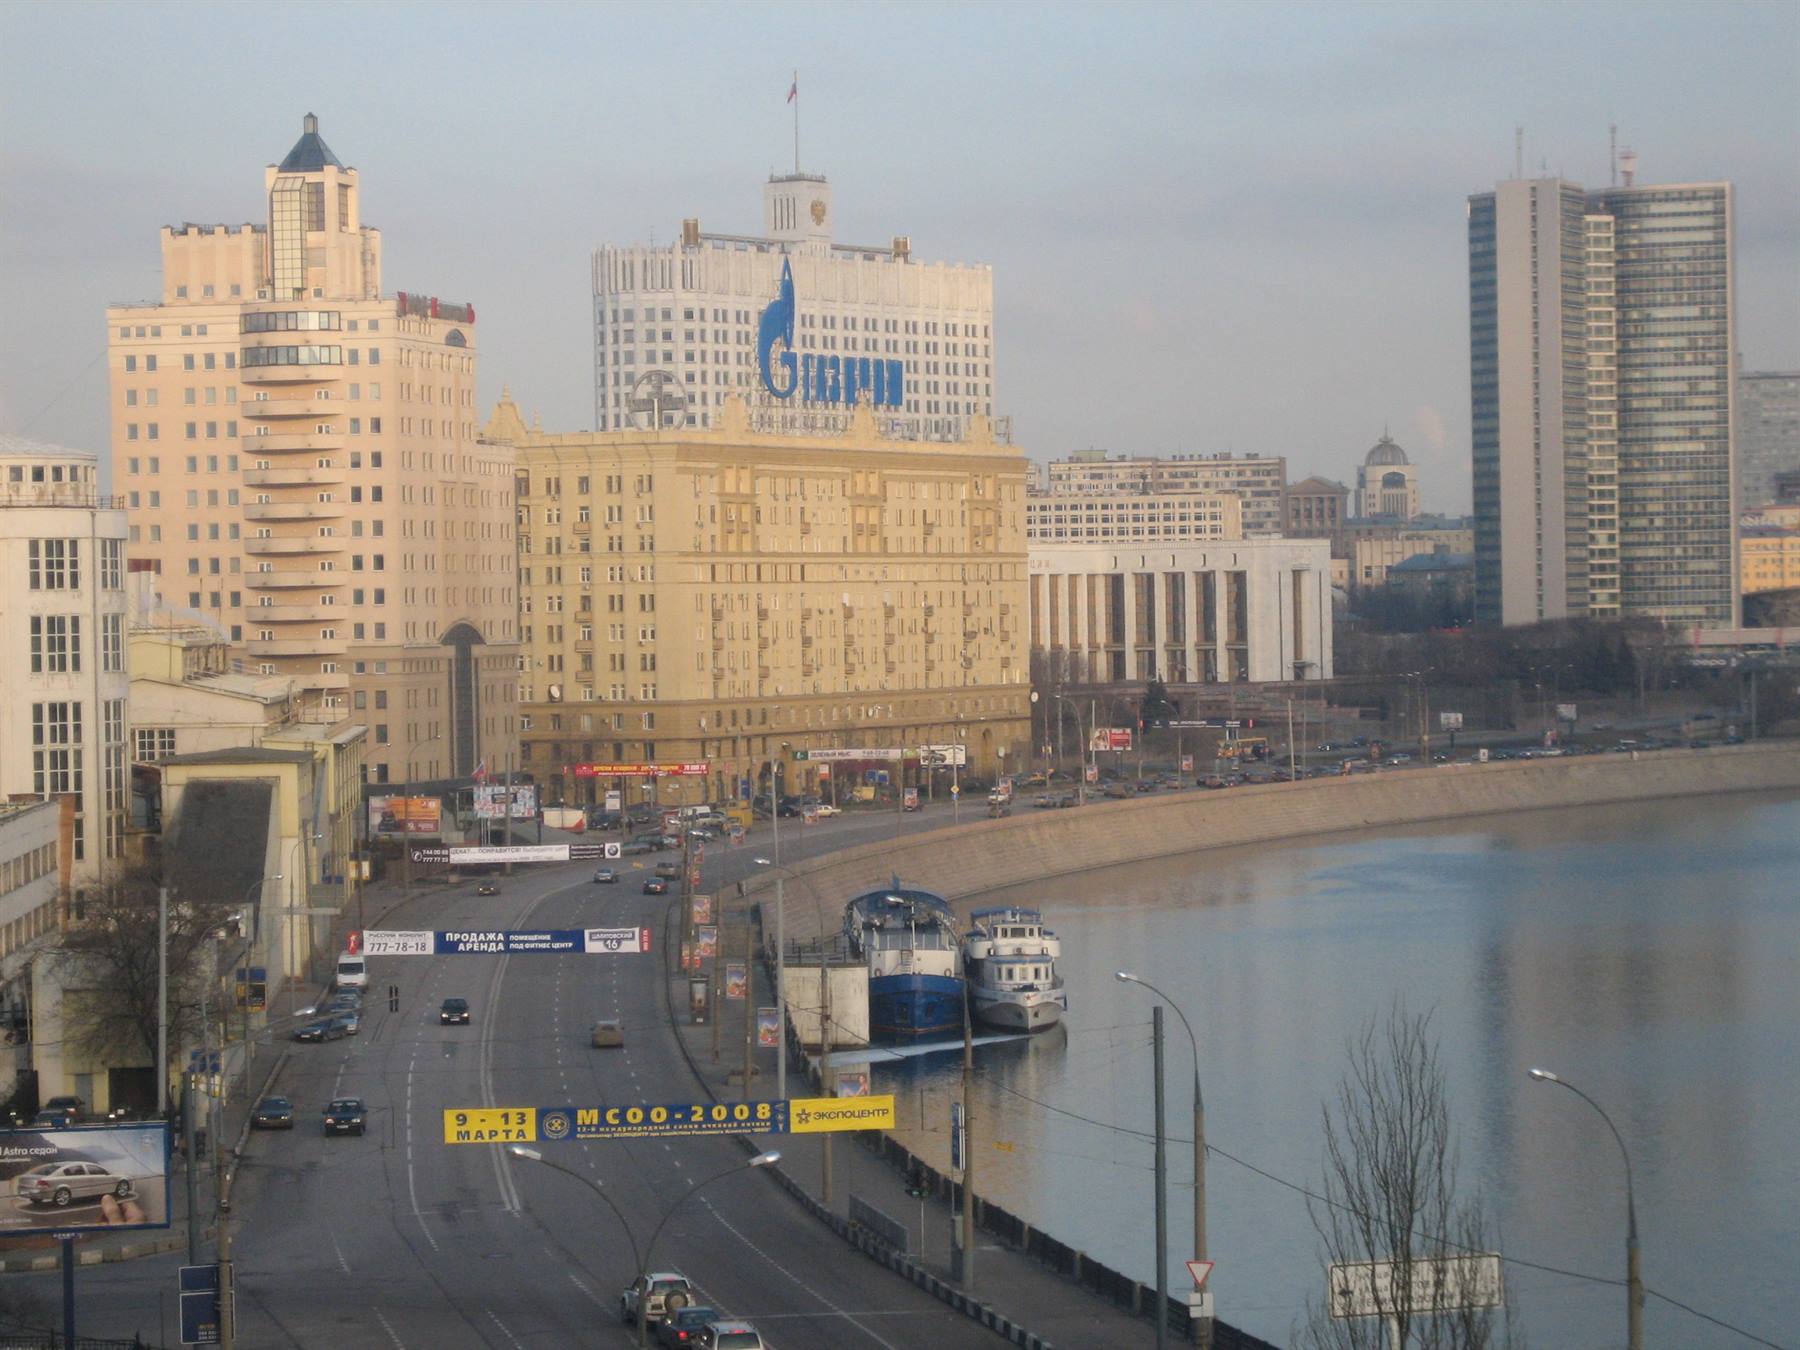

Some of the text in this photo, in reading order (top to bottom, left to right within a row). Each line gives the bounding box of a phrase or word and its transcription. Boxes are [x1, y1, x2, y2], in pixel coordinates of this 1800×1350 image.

[445, 932, 504, 942] ПРОДАЖА
[369, 942, 427, 952] 777-78-18
[458, 943, 504, 952] АРЕНДА
[509, 942, 524, 950] ПОД
[605, 940, 618, 949] 16
[813, 1109, 889, 1121] ЭКСПОЦЕНТР
[456, 1129, 527, 1141] МАРТА
